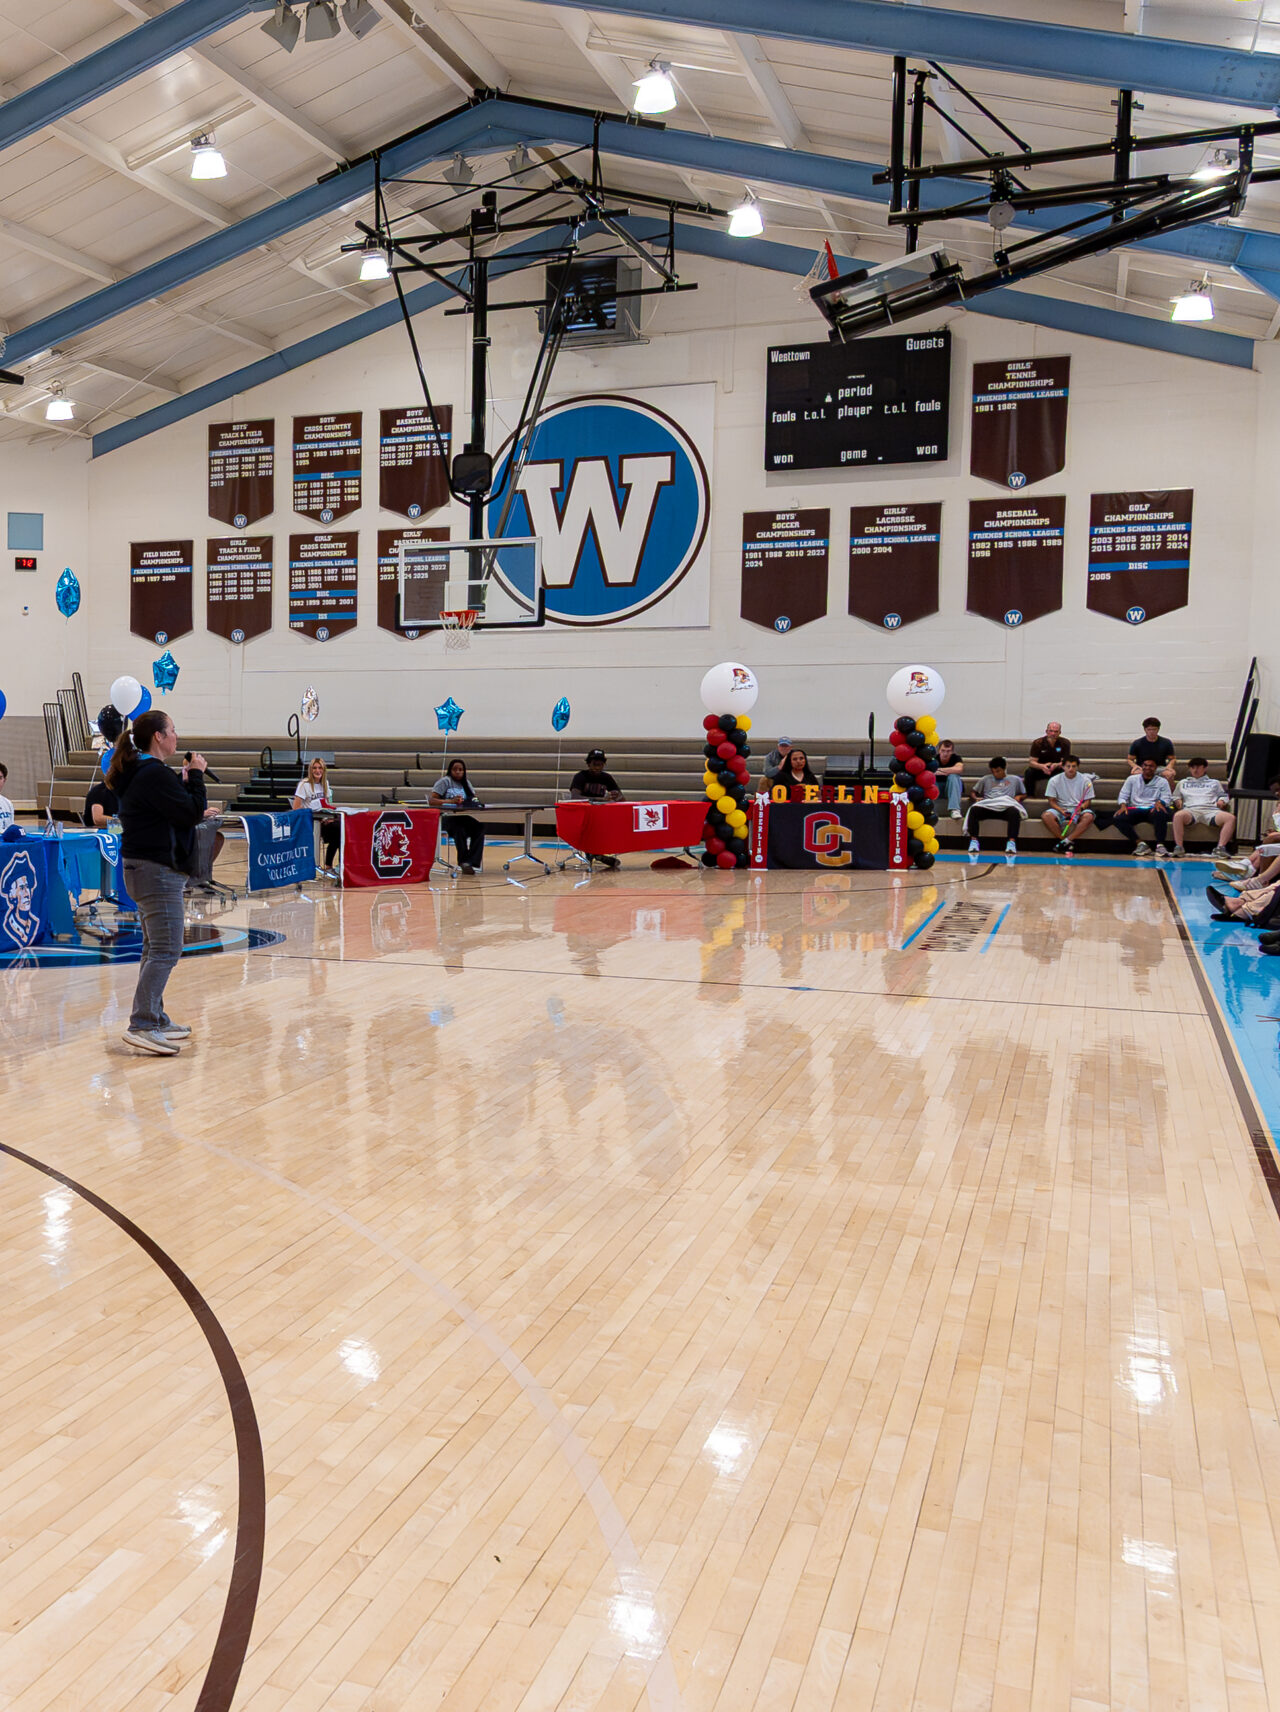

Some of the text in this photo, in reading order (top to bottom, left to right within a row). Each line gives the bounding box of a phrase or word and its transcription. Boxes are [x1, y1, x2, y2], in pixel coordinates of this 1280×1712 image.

[907, 338, 944, 350] Guests
[771, 351, 810, 362] Westtown
[1008, 362, 1033, 370] GIRLS'
[1006, 371, 1036, 380] TENNIS
[988, 379, 1054, 390] CHAMPIONSHIPS
[838, 384, 872, 400] period
[772, 411, 796, 423] fouls
[838, 405, 872, 420] player
[916, 400, 940, 412] fouls
[774, 445, 937, 464] won game won
[997, 510, 1038, 518] BASEBALL
[1105, 512, 1174, 522] CHAMPIONSHIPS
[511, 451, 676, 590] W
[876, 516, 915, 524] LACROSSE
[984, 518, 1050, 527] CHAMPIONSHIPS
[865, 524, 926, 533] CHAMPIONSHIPS
[756, 530, 815, 538] CHAMPIONSHIPS
[1128, 562, 1148, 570] DISC
